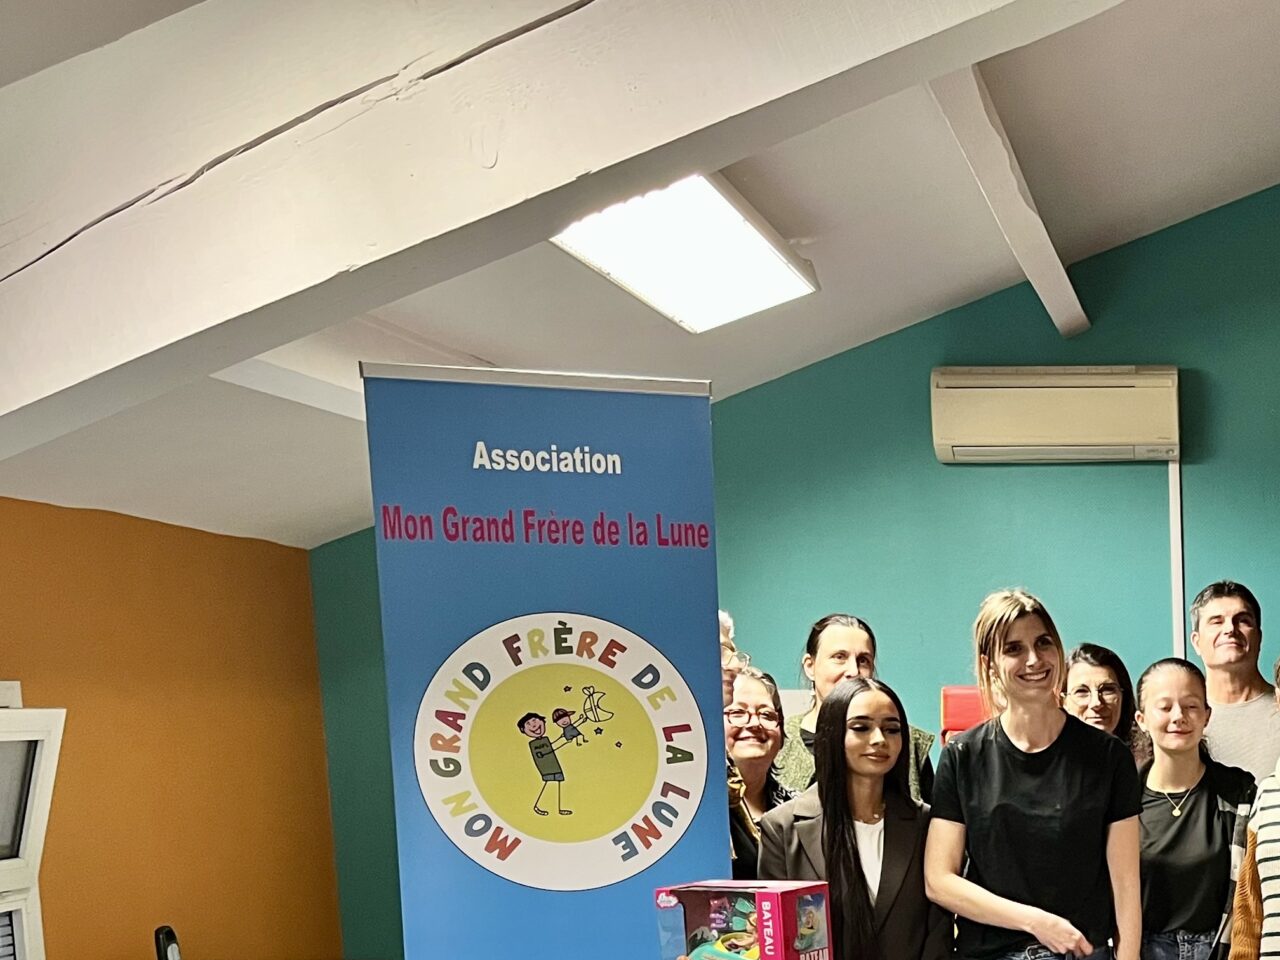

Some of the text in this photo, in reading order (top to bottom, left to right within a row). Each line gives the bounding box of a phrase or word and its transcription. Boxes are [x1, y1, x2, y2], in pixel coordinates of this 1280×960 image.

[473, 441, 622, 474] Association
[382, 505, 710, 548] Mon Grand Frère de la Lune
[429, 621, 693, 861] MON GRAND FRÈRE DE LA LUNE
[762, 901, 774, 956] BATEAU
